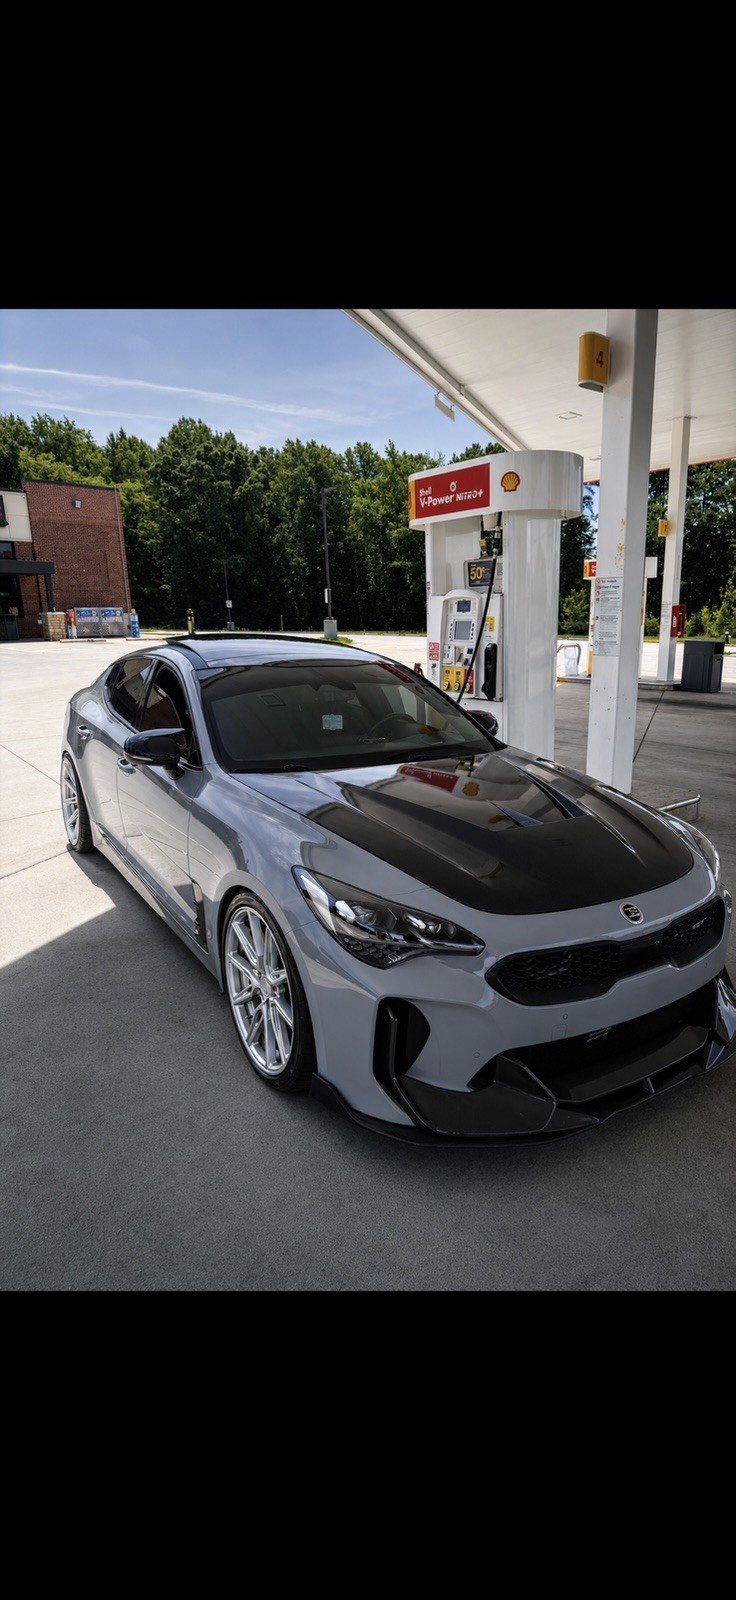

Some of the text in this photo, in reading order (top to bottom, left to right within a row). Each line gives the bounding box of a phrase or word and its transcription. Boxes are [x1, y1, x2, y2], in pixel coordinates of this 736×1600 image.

[596, 351, 604, 368] 4
[419, 487, 432, 497] Shell
[419, 495, 454, 508] V-Power
